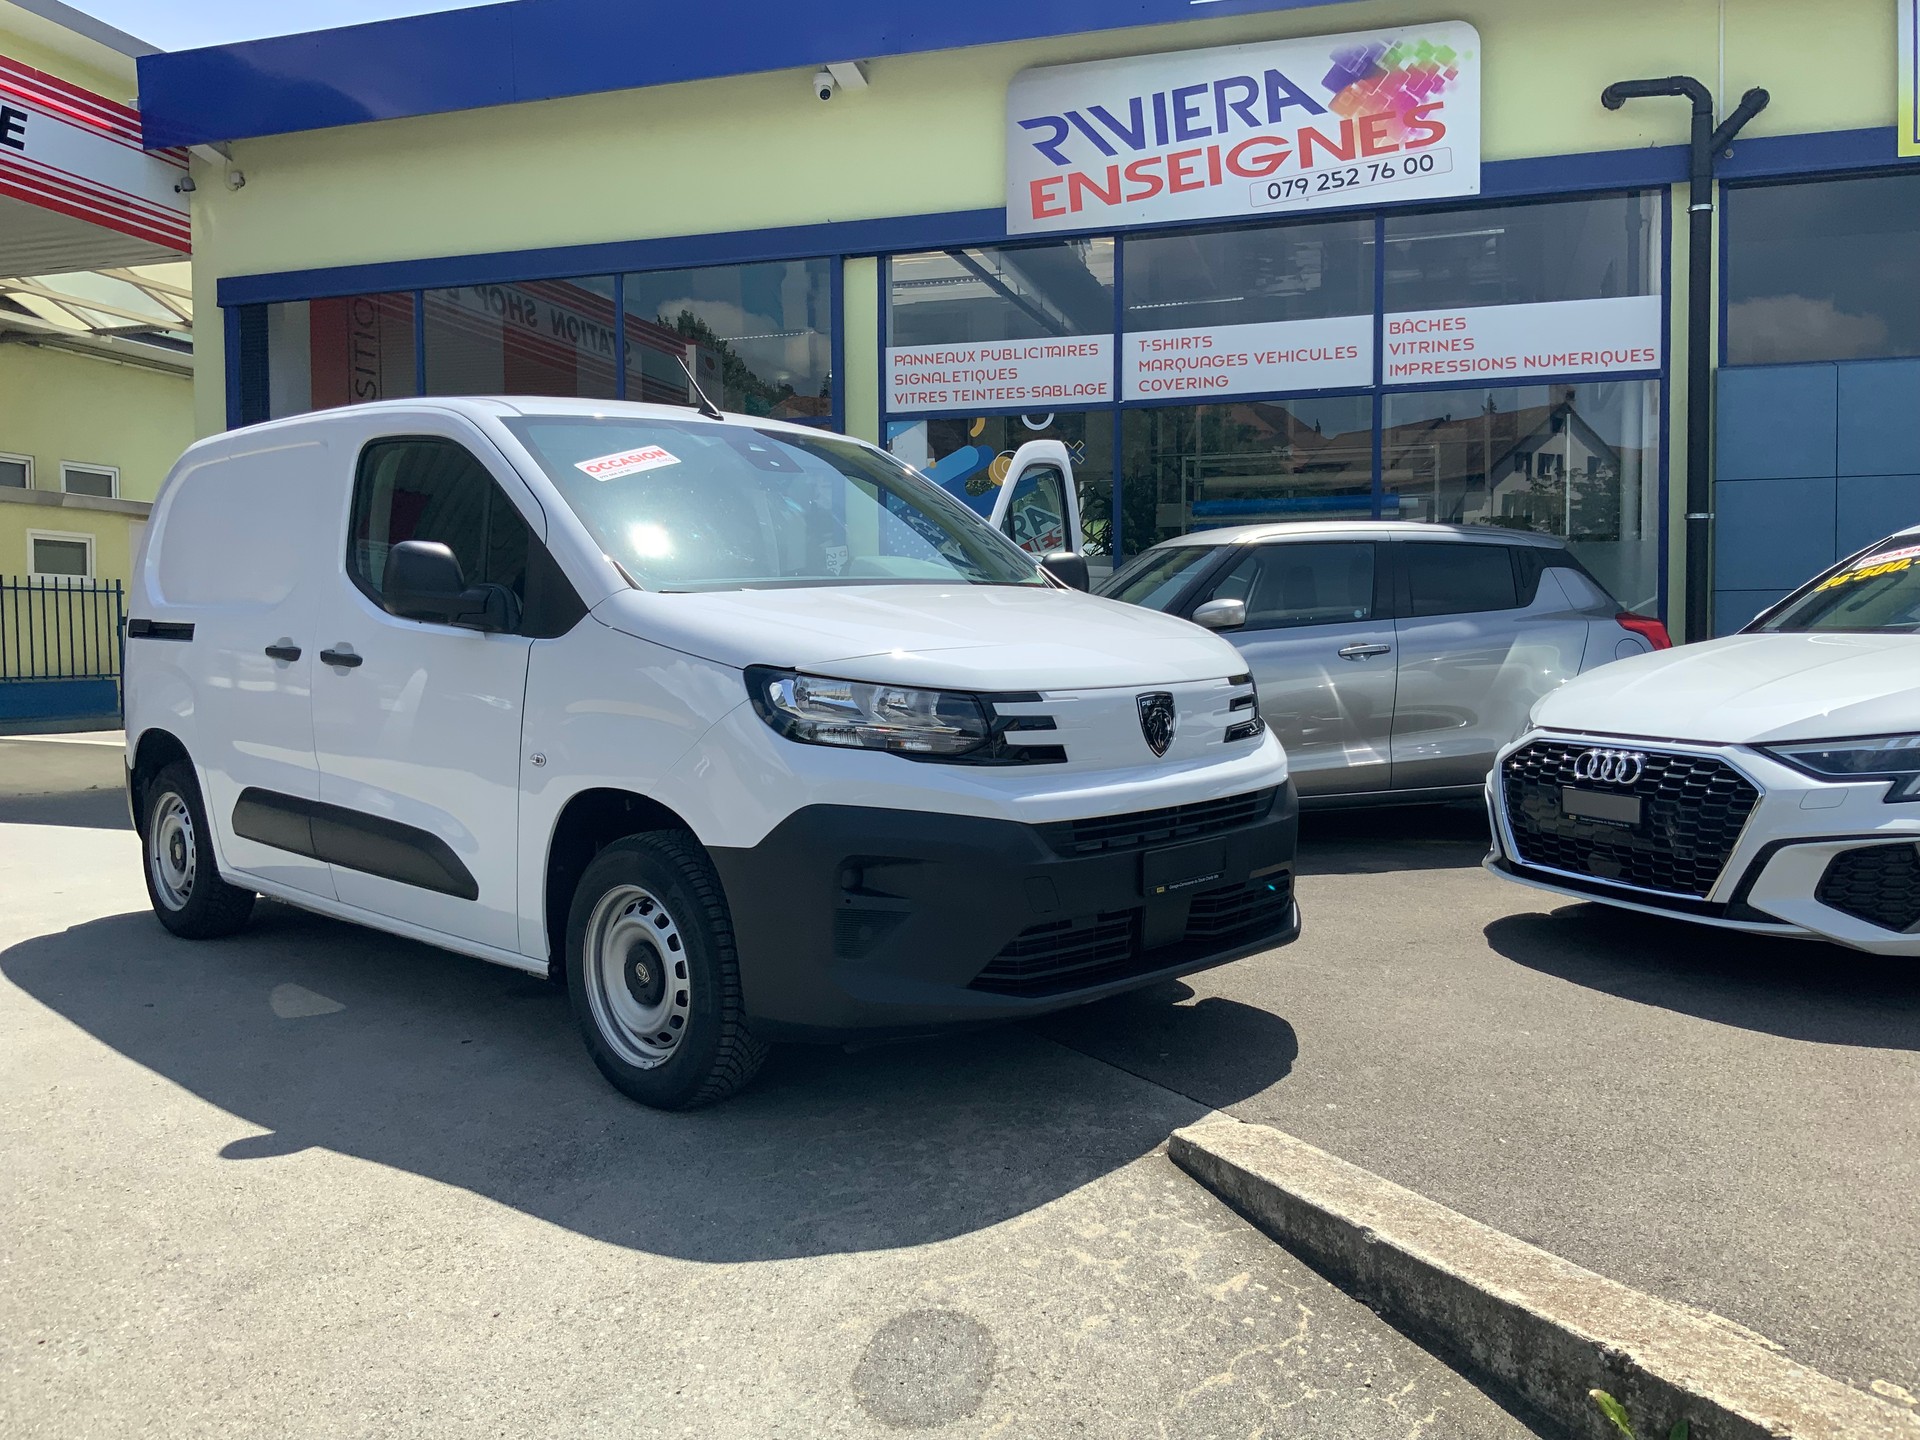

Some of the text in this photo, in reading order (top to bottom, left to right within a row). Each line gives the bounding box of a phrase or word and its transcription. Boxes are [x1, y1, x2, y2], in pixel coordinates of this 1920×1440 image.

[1017, 69, 1328, 166] RIVIERA
[1030, 101, 1446, 220] ENSEIGNES
[1267, 154, 1434, 200] 079 252 76 00
[1389, 317, 1467, 335] BÂCHES
[894, 343, 1099, 367] PANNEAUX PUBLICITAIRES
[1138, 335, 1213, 352] T-SHIRTS
[1389, 338, 1475, 356] VITRINES
[1138, 346, 1358, 373] MARQUAGES VEHICULES
[1389, 348, 1655, 377] IMPRESSIONS NUMERIQUES
[894, 367, 1018, 386] SIGNALETIQUES
[1138, 375, 1229, 392] COVERING
[894, 382, 1108, 405] VITRES TEINTEES-SABLAGE
[586, 450, 668, 473] OCCASION
[1862, 546, 1920, 565] OCCASI
